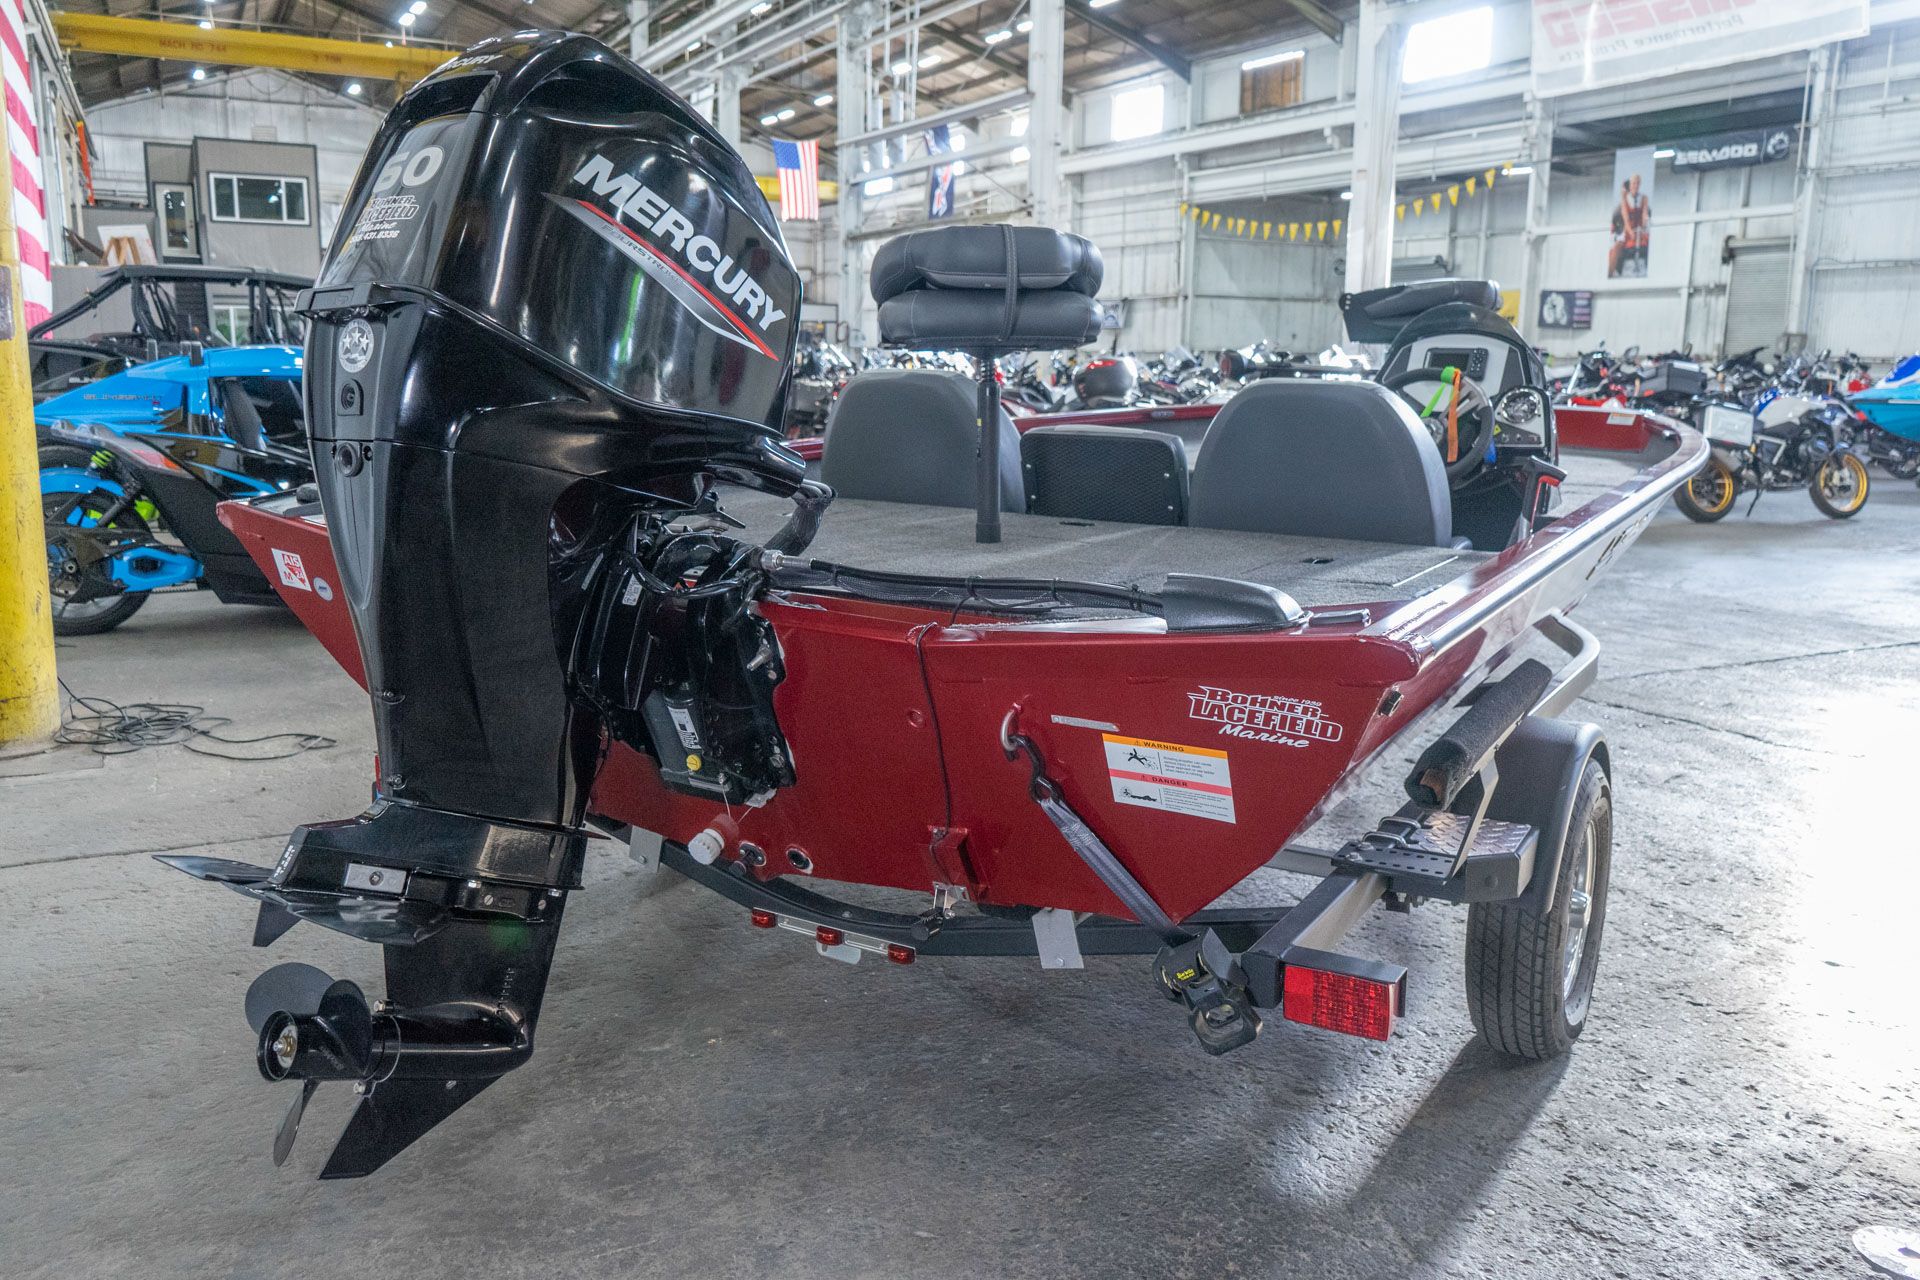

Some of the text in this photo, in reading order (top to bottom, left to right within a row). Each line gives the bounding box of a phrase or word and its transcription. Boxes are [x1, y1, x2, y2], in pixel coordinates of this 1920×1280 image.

[573, 153, 786, 331] MERCURY
[1198, 685, 1330, 719] BOHNER
[1187, 693, 1343, 742] LACEFIELD
[1143, 741, 1185, 752] WARNING
[1218, 723, 1310, 748] Marine
[1152, 776, 1188, 787] DANGER
